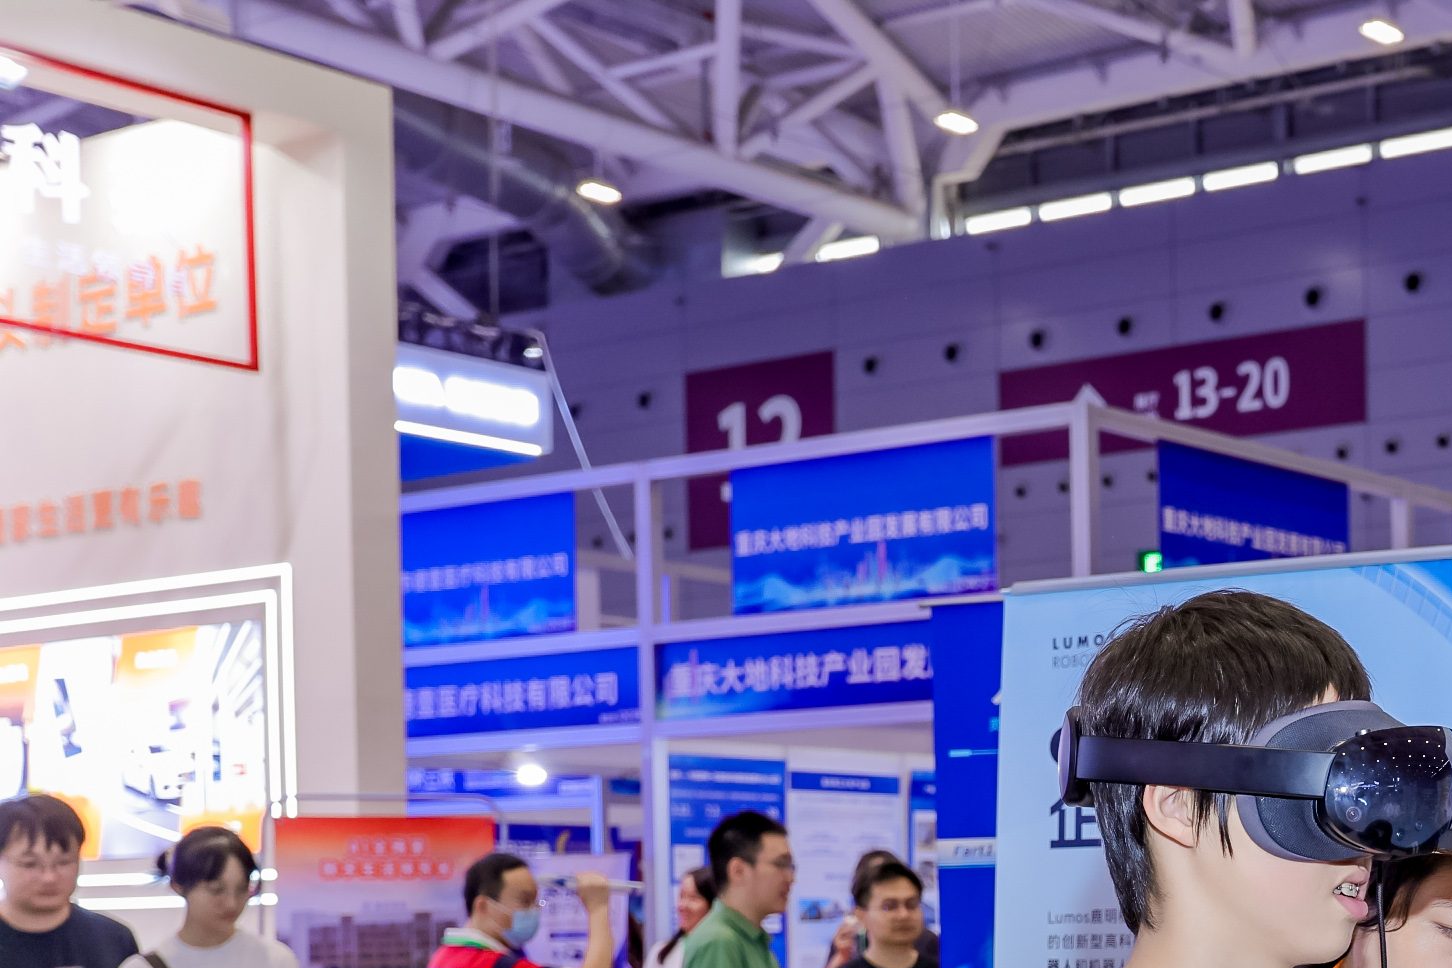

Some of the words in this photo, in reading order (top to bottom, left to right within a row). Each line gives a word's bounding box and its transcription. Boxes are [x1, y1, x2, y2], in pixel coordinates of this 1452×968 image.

[1173, 356, 1290, 420] 13-20
[735, 503, 989, 556] 重庆大地科技产业园发展有限公司
[668, 643, 934, 697] 重庆大地科技产业园发
